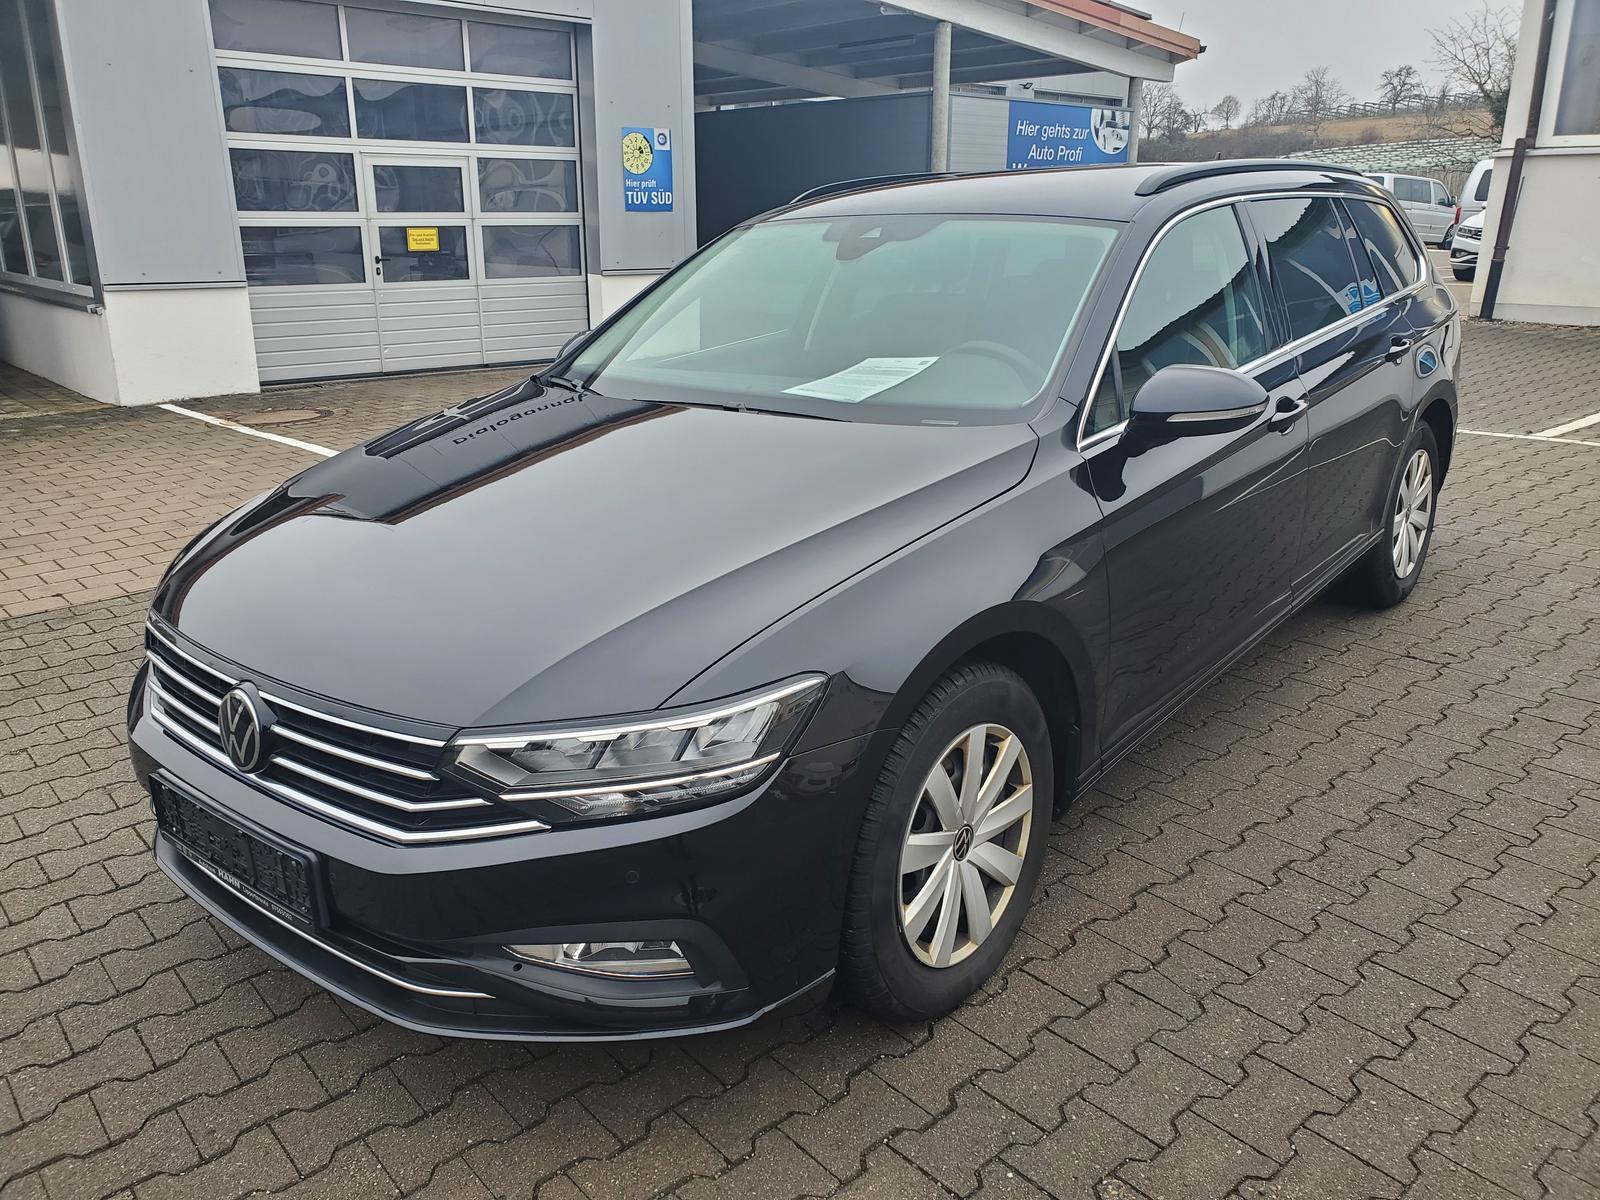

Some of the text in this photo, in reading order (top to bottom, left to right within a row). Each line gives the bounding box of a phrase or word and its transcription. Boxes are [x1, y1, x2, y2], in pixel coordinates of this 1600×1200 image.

[1016, 120, 1090, 141] Hier gehts zur
[1028, 144, 1083, 161] Auto Profi
[626, 179, 656, 189] Hier prüft
[626, 188, 672, 204] TÜV SÜD
